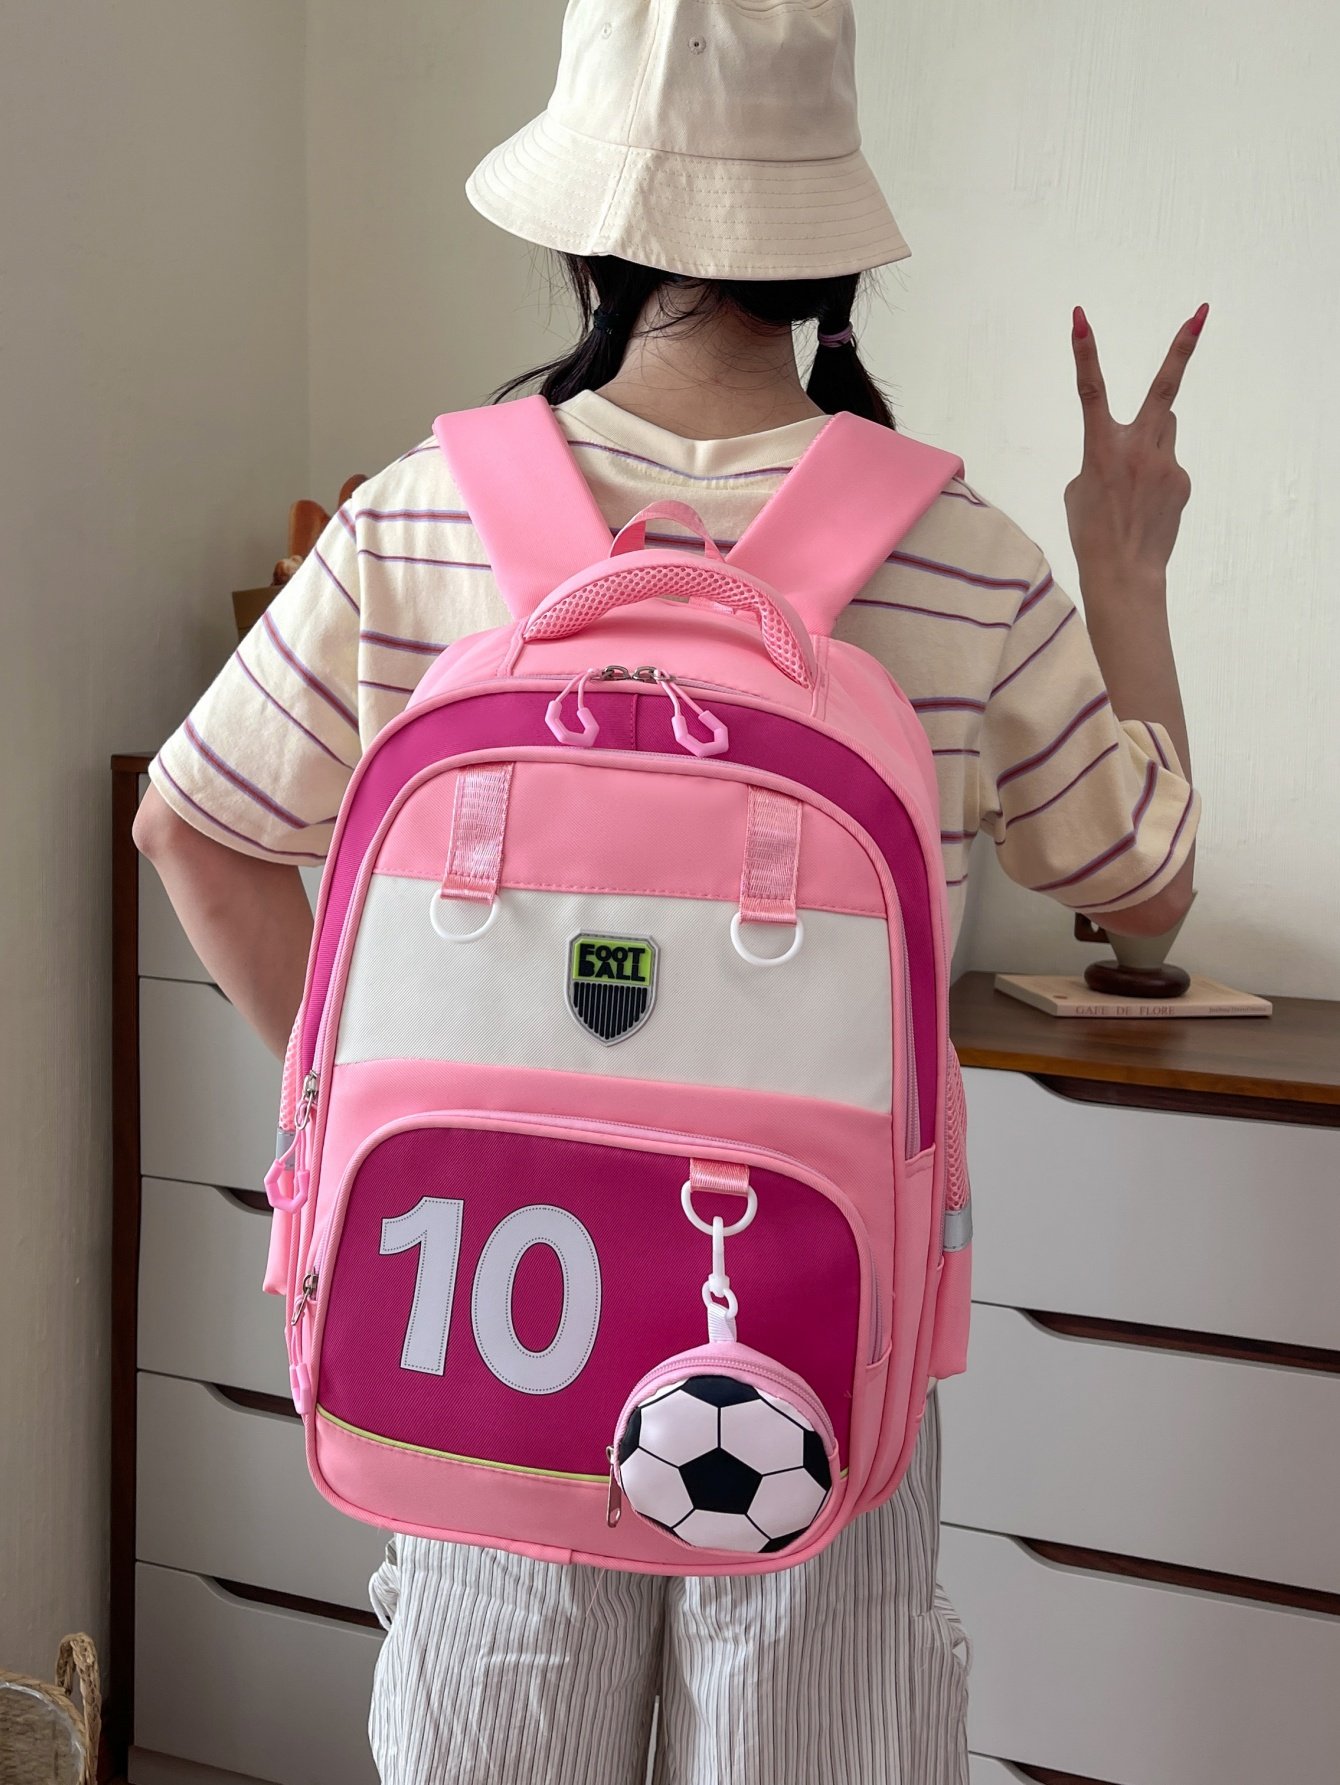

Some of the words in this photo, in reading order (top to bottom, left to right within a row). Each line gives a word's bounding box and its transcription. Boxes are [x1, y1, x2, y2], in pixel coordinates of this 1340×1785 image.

[579, 943, 645, 964] FOOT
[578, 960, 645, 982] BALL
[1139, 1006, 1176, 1016] FLORE
[378, 1195, 602, 1395] 10
